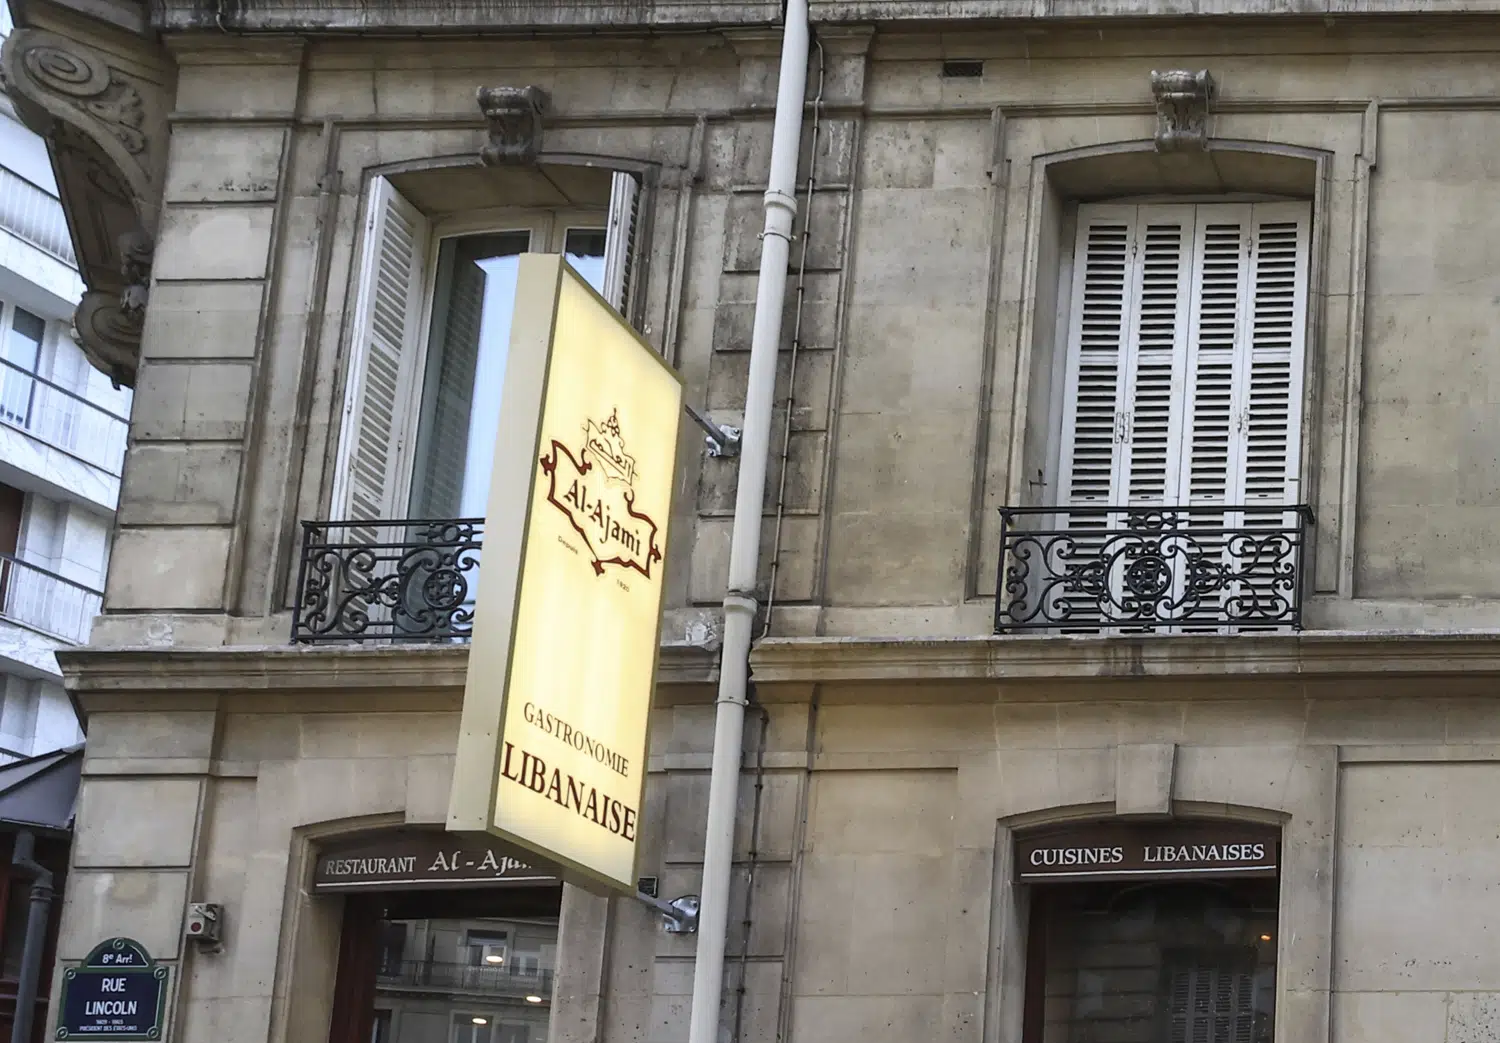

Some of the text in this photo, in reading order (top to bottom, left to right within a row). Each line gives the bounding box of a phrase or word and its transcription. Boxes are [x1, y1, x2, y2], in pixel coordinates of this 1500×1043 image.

[563, 479, 641, 556] Al-Ajami
[524, 702, 628, 777] GASTRONOMIE
[501, 741, 636, 842] LIBANAISE
[325, 857, 416, 875] RESTAURANT
[1030, 844, 1265, 866] CUISINES LIBANAISES
[101, 978, 127, 992] RUE
[85, 1001, 137, 1015] LINCOLN
